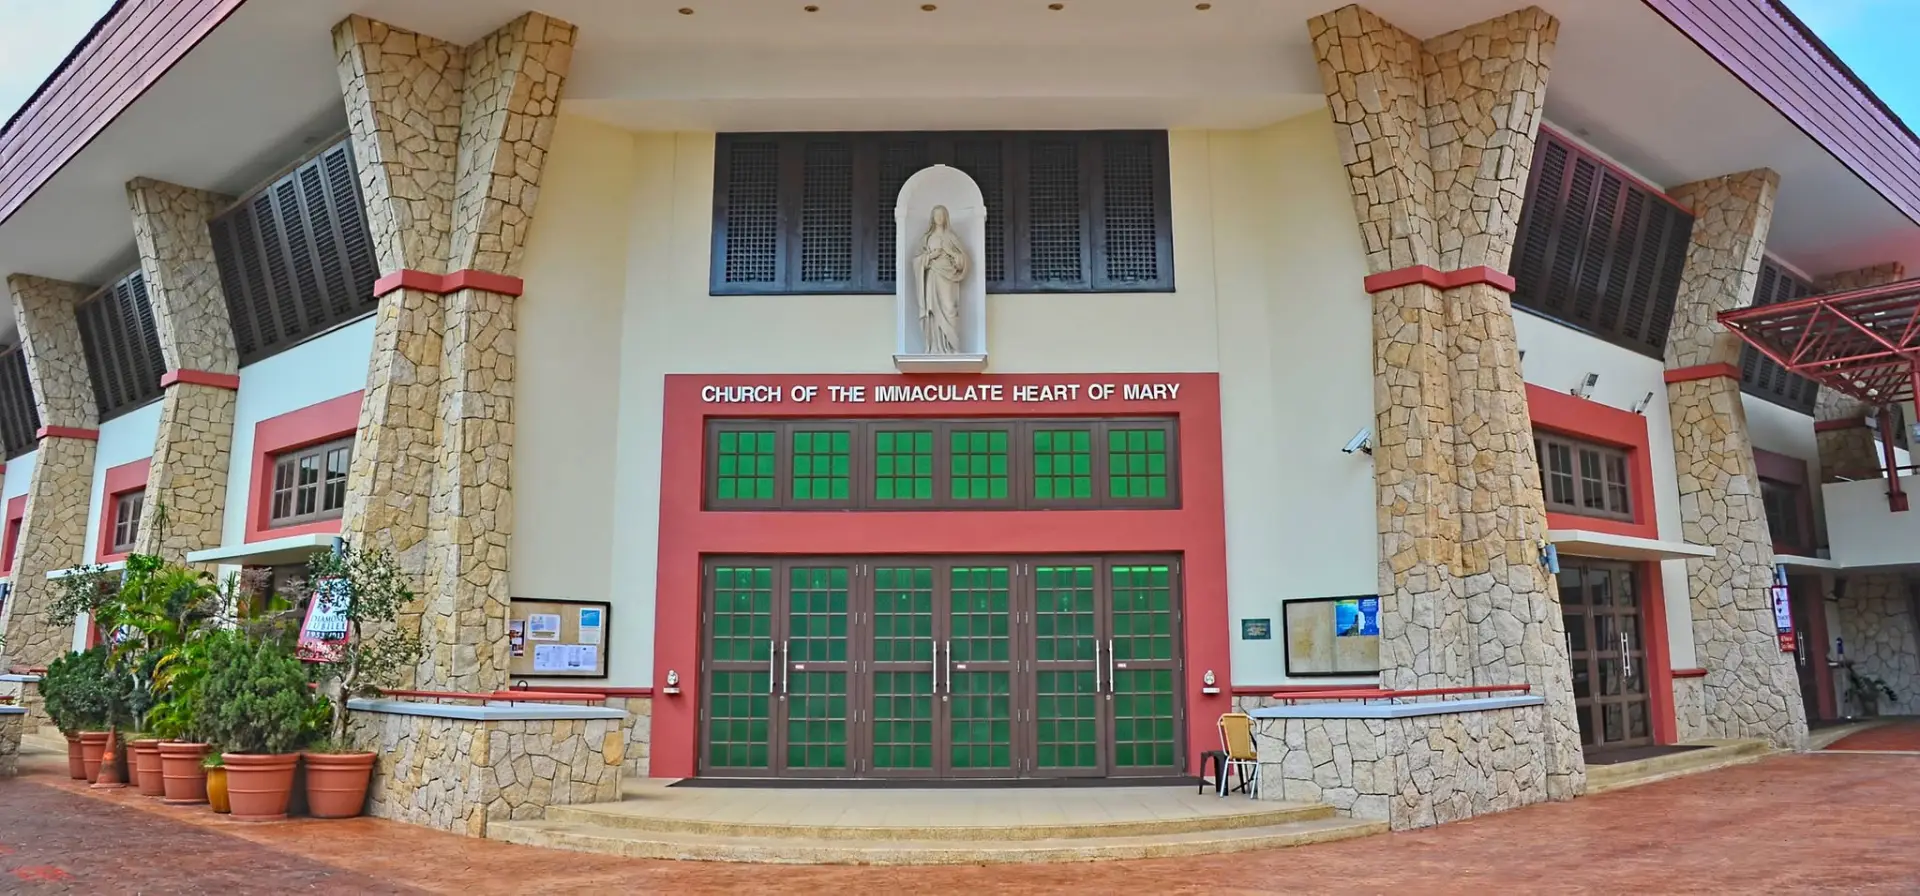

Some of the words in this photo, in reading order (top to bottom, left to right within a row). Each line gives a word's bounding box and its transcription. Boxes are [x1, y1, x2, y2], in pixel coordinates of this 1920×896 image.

[701, 385, 781, 403] CHURCH
[790, 385, 819, 402] OF
[827, 385, 866, 402] THE
[874, 384, 1004, 402] IMMACULATE
[1013, 383, 1081, 402] HEART
[1087, 383, 1115, 401] OF
[1123, 383, 1180, 401] MARY
